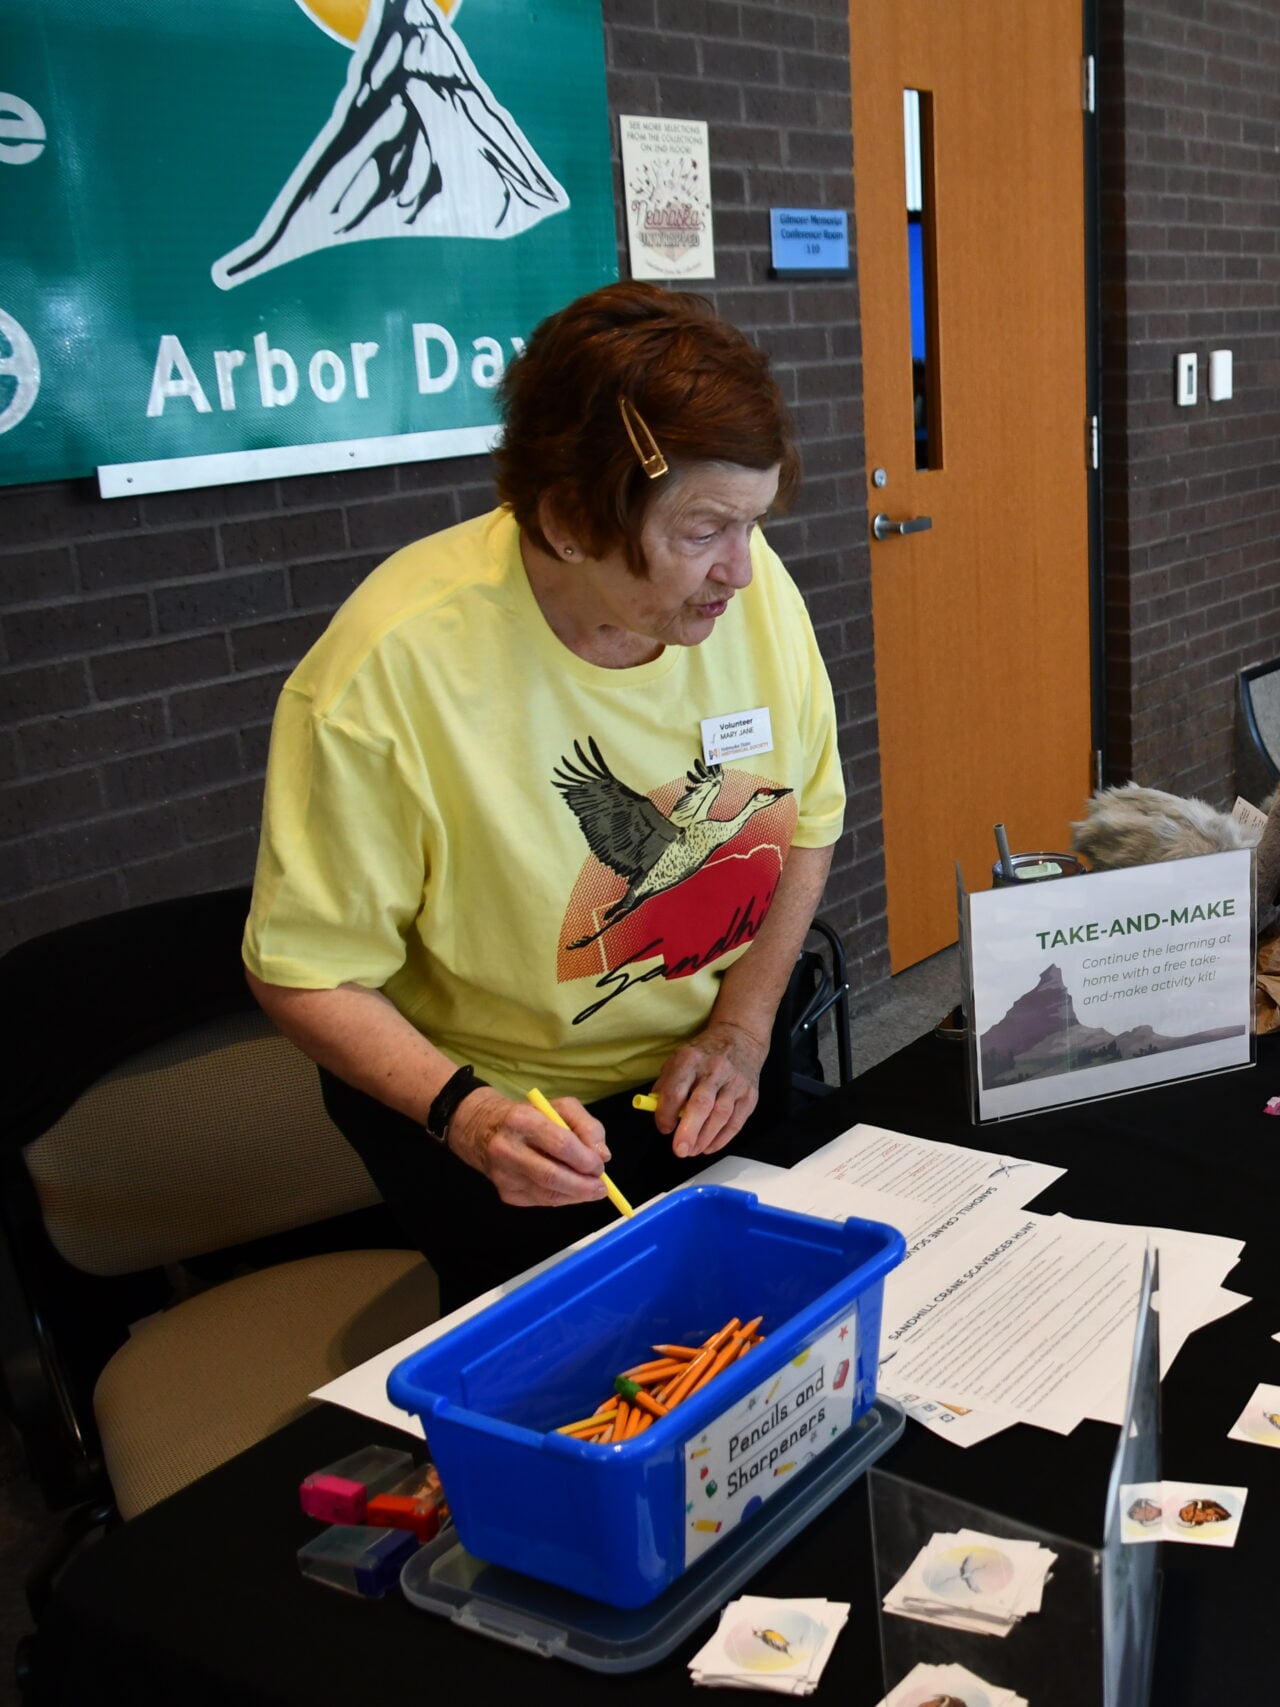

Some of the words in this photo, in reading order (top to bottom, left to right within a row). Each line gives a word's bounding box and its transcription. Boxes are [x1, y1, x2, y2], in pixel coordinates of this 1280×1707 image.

[660, 134, 704, 144] COLLECTIONS
[664, 123, 700, 134] SELECTIONS
[146, 331, 379, 418] Arbor
[720, 718, 753, 730] Volunteer
[720, 731, 738, 740] MARY
[739, 727, 754, 737] JANE
[1036, 898, 1236, 950] TAKE-AND-MAKE
[1082, 951, 1140, 970] Continue
[1142, 946, 1162, 958] the
[1165, 936, 1216, 954] learning
[1218, 934, 1232, 944] at
[1083, 972, 1120, 988] home
[1122, 965, 1149, 980] with
[1152, 966, 1161, 974] a
[1164, 959, 1187, 973] free
[1190, 953, 1221, 967] take-
[1083, 984, 1148, 1006] and-make
[1151, 975, 1196, 992] activity
[1198, 970, 1217, 983] kit!
[956, 1186, 998, 1216] SANDHILL
[927, 1216, 959, 1239] CRANE
[904, 1238, 932, 1260] SCAVE
[888, 1303, 938, 1342] SANDHILL
[933, 1278, 968, 1303] CRANE
[963, 1239, 1015, 1280] SCAVENGER
[1010, 1221, 1038, 1241] HUNT
[729, 1402, 788, 1463] Pencils
[795, 1366, 825, 1408] and
[727, 1407, 826, 1499] Sharpeners
